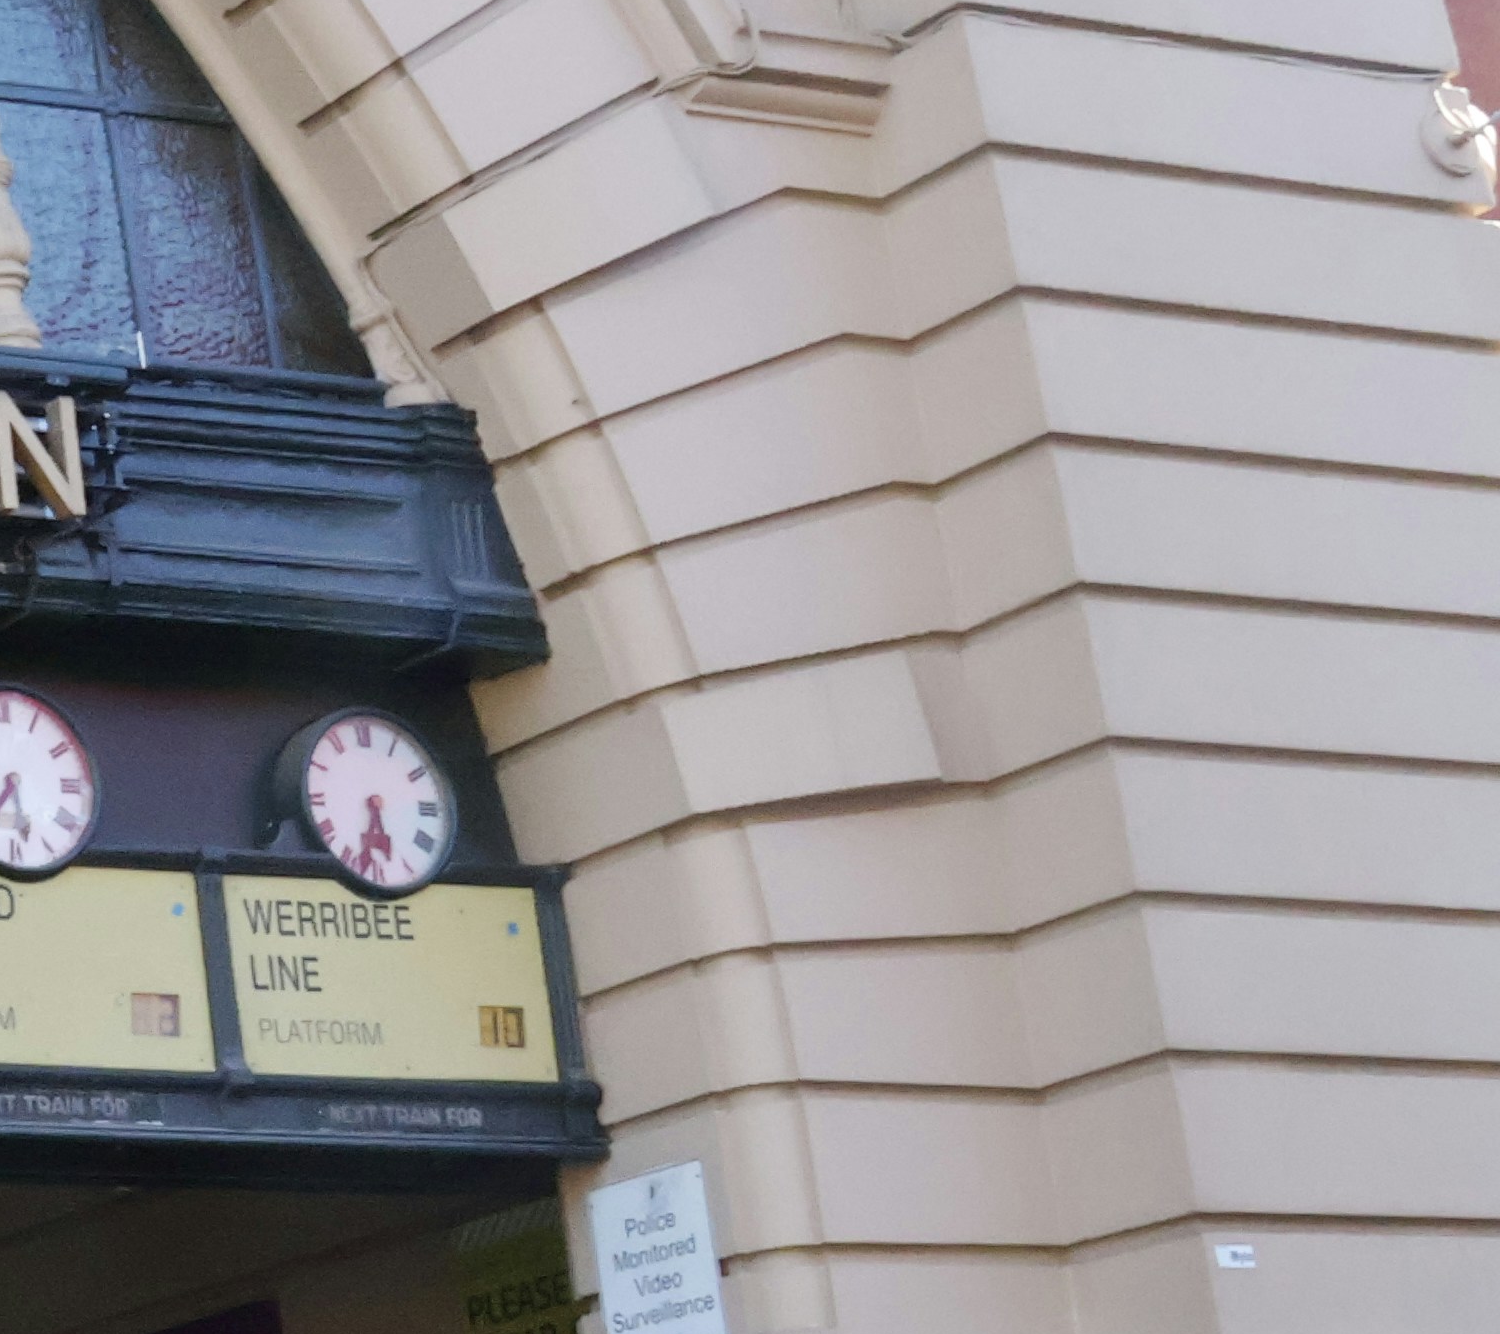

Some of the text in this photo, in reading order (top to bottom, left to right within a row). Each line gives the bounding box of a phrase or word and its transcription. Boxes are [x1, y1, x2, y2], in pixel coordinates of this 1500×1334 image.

[243, 898, 415, 941] WERRIBEE
[249, 954, 323, 993] LINE
[258, 1006, 526, 1049] PLATFORM 10
[23, 1094, 84, 1115] TRAIN
[89, 1096, 130, 1117] FOR
[327, 1103, 483, 1128] NEXT TRAIN FOR
[624, 1210, 677, 1239] Police
[612, 1233, 697, 1272] Monitored
[466, 1271, 571, 1326] PLEASE
[633, 1270, 683, 1298] Video
[612, 1293, 715, 1334] Surveillance
